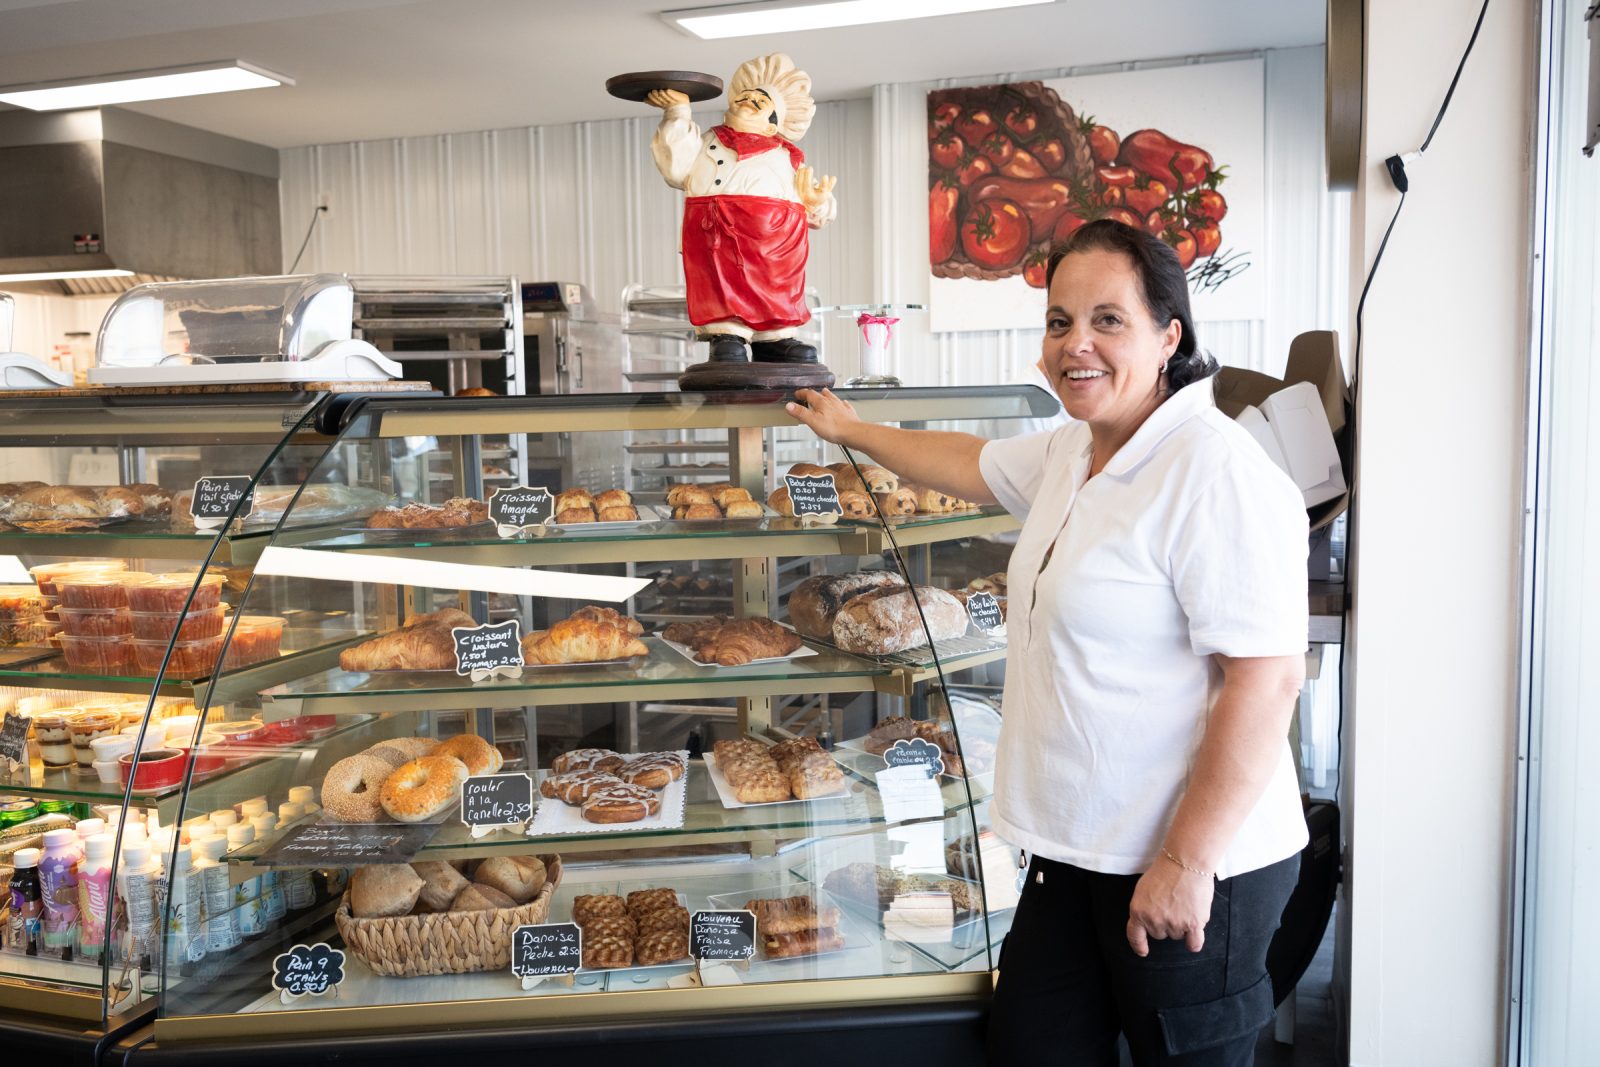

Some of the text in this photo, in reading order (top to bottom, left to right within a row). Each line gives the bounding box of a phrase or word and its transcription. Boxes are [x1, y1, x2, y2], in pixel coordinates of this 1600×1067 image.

[201, 480, 221, 492] Pain
[201, 502, 222, 514] 4.50
[500, 504, 539, 514] Amande
[460, 628, 512, 645] Croissant
[461, 660, 498, 669] Fromage
[503, 802, 532, 816] 2.50
[694, 924, 738, 934] Danoise
[522, 929, 576, 945] Danoise
[697, 935, 731, 945] Fraise
[522, 945, 556, 962] Pêche
[700, 946, 740, 958] Fromage
[288, 954, 328, 970] Pain 9
[290, 980, 328, 992] 0.50$
